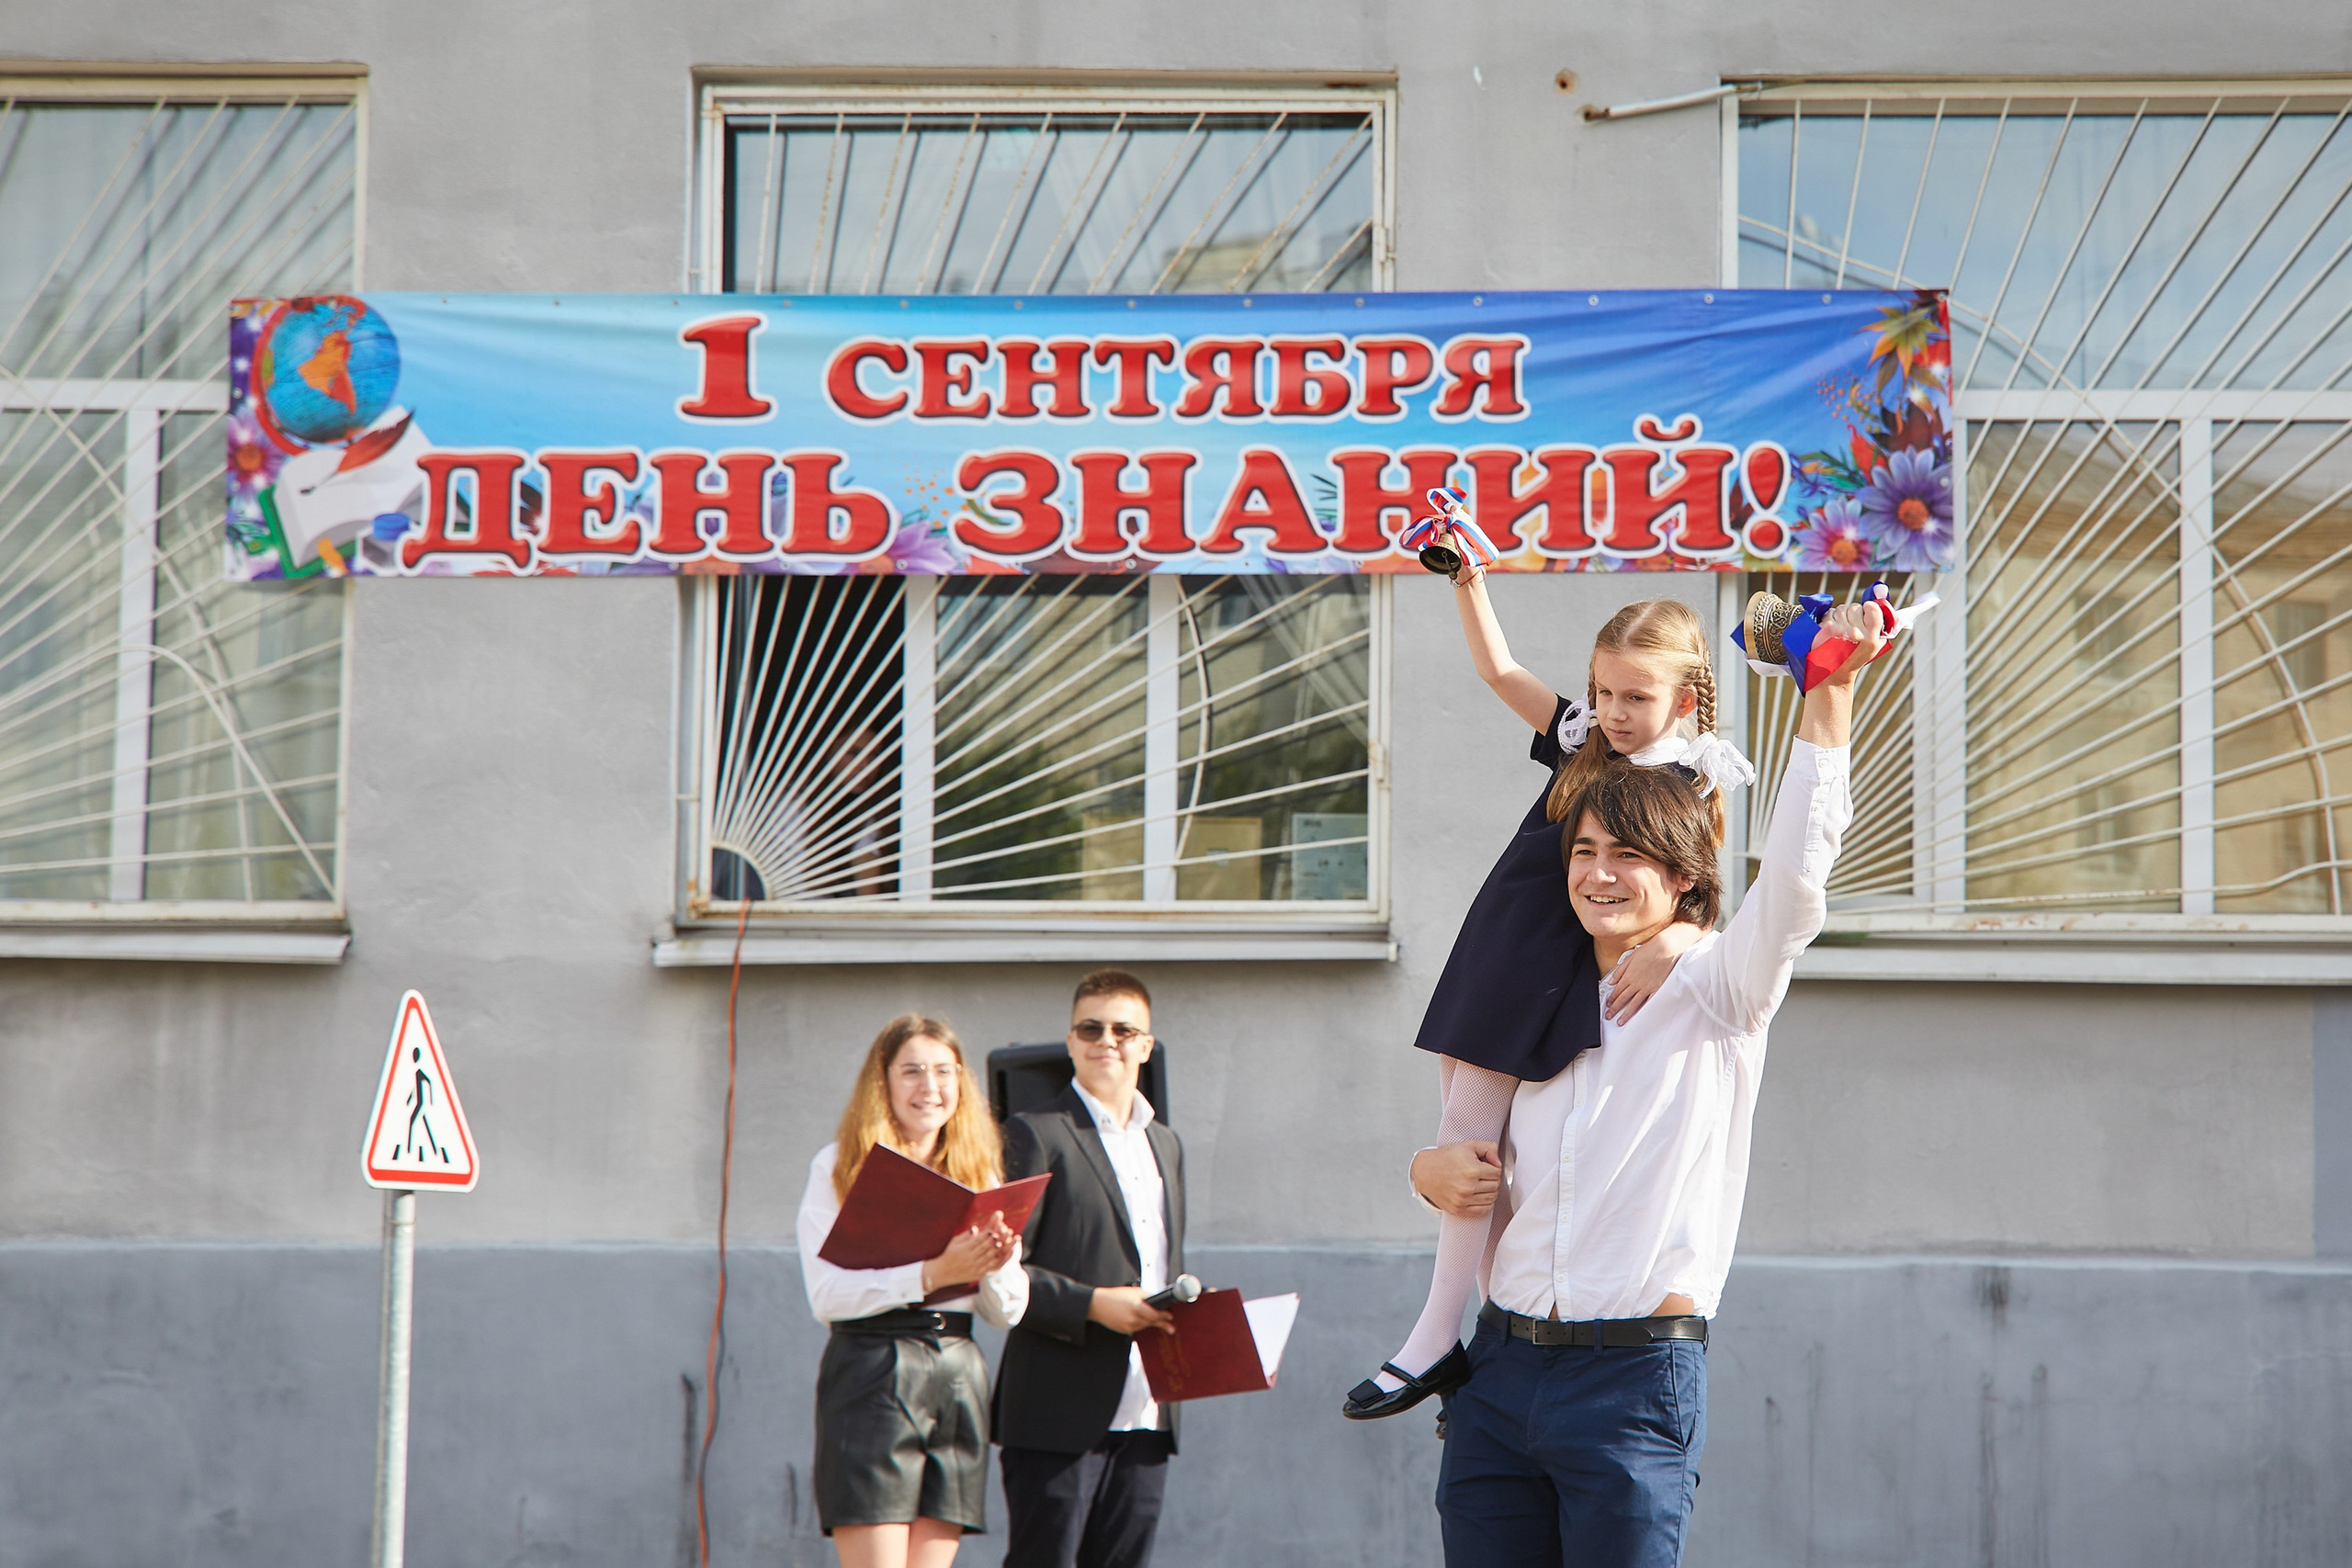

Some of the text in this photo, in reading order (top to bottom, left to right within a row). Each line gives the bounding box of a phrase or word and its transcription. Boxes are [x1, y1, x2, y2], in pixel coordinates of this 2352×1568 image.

[681, 314, 1527, 420] 1 СЕНТЯБРЯ
[401, 416, 1786, 570] ДЕНЬ ЗНАНИЙ!
